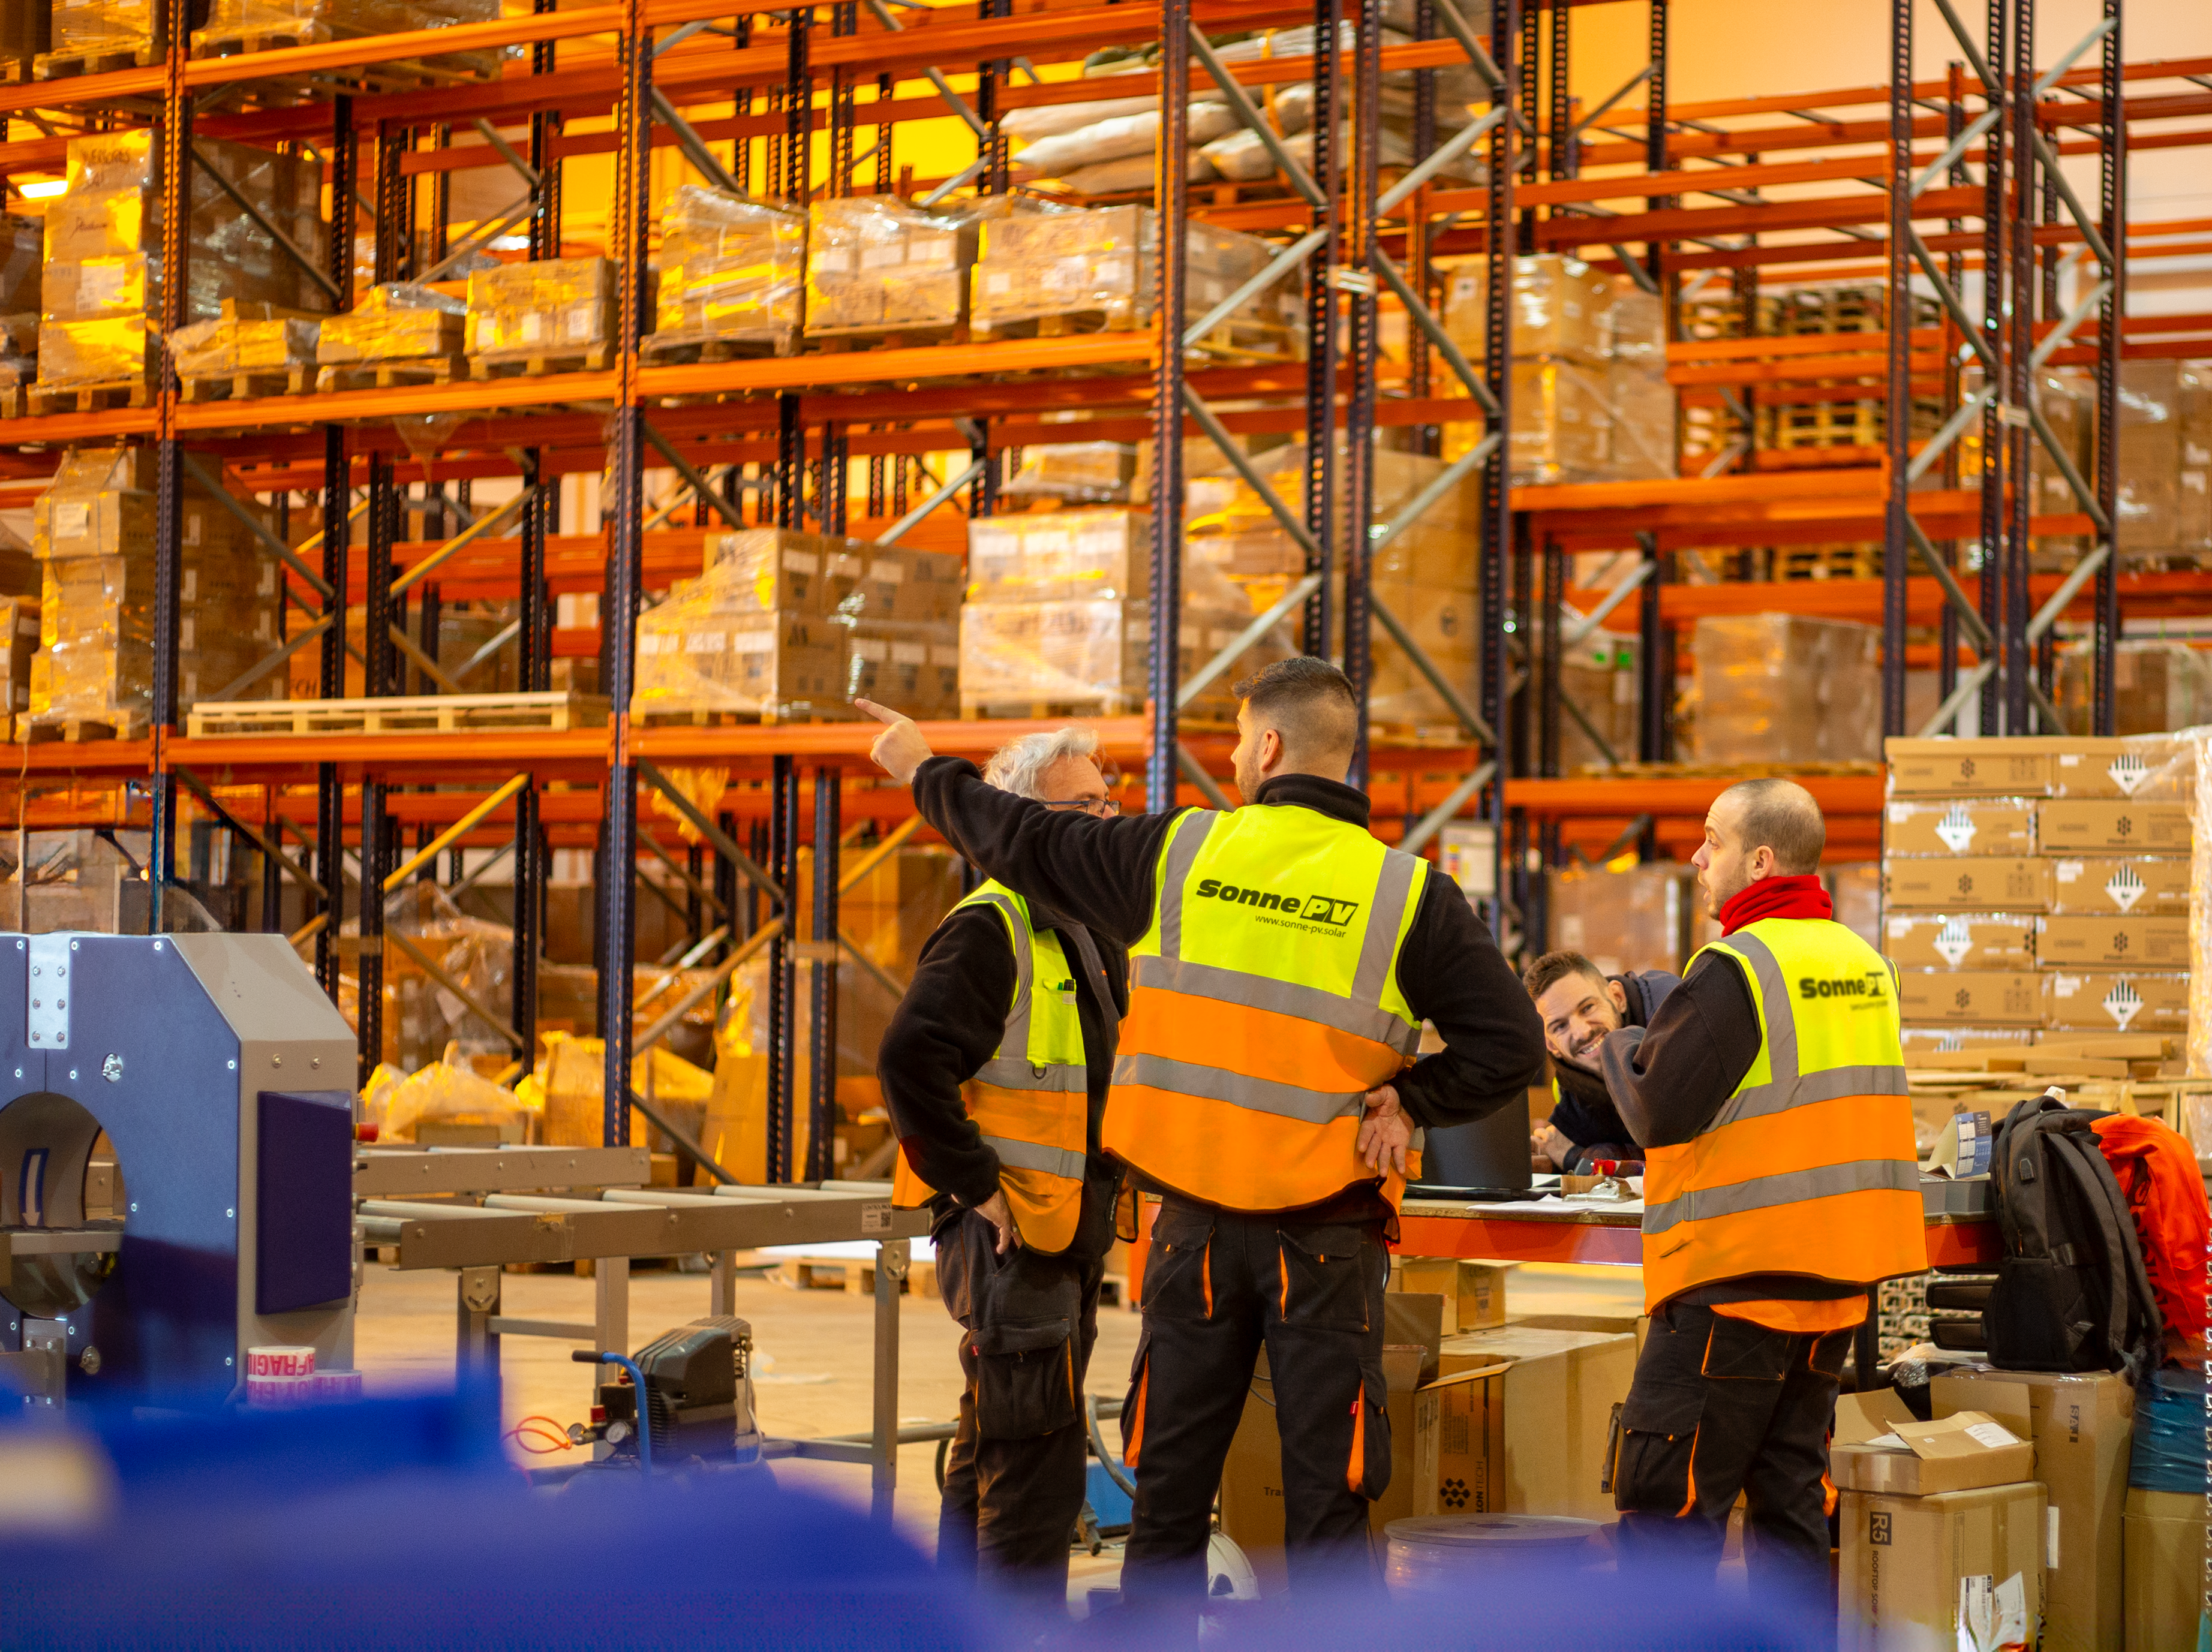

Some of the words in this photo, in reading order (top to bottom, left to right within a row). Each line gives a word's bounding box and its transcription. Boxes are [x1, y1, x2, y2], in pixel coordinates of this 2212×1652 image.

[1196, 878, 1301, 913] Sonne
[1255, 914, 1347, 938] www.sonne-pv.solar
[1799, 977, 1865, 999] Sonne
[1475, 1461, 1484, 1513] LONTECH
[1871, 1513, 1889, 1543] R5
